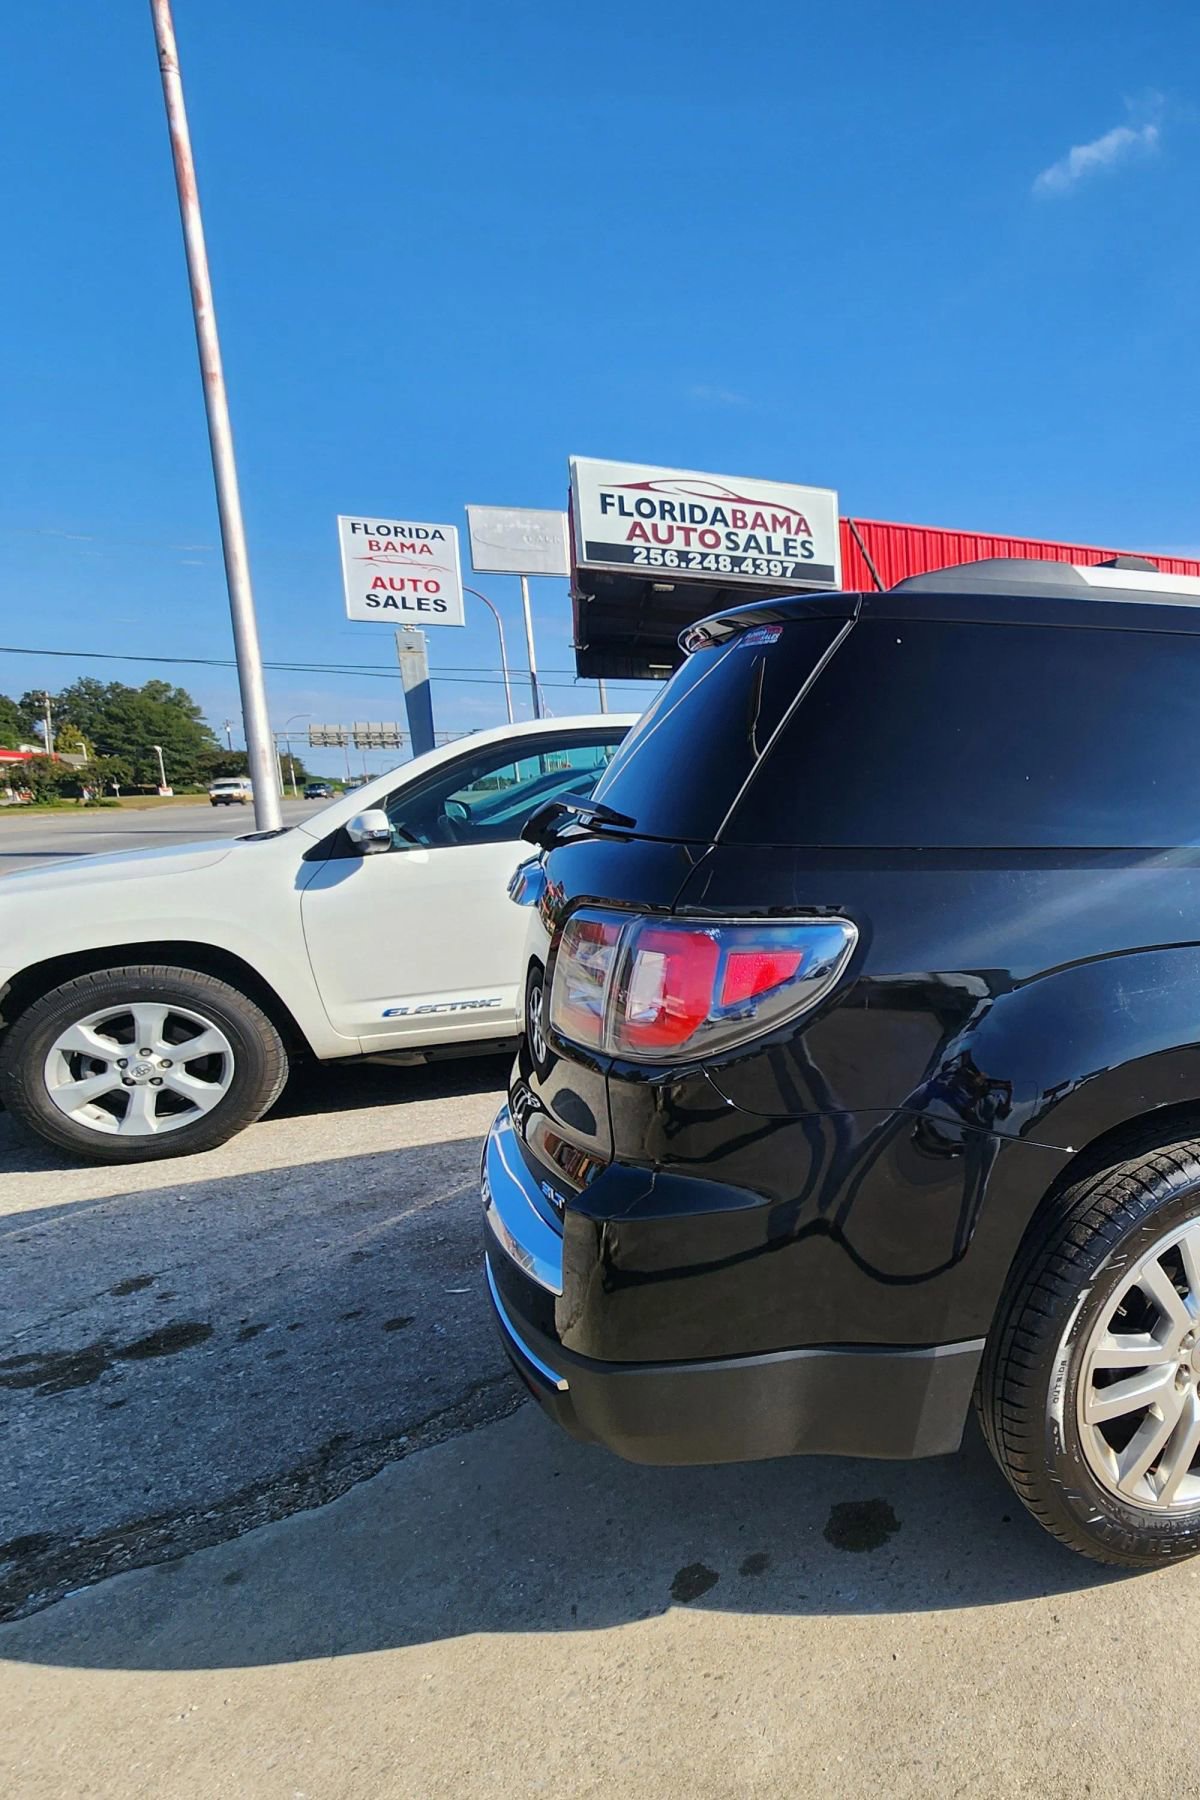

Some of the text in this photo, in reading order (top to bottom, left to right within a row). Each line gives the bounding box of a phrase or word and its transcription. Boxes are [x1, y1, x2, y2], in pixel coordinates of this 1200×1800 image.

[599, 493, 813, 538] FLORIDABAMA
[351, 522, 446, 541] FLORIDA
[368, 540, 434, 556] BAMA
[633, 547, 796, 577] 256.248.4397
[371, 576, 440, 593] AUTO
[365, 594, 448, 612] SALES
[382, 998, 503, 1017] ELECTRIC
